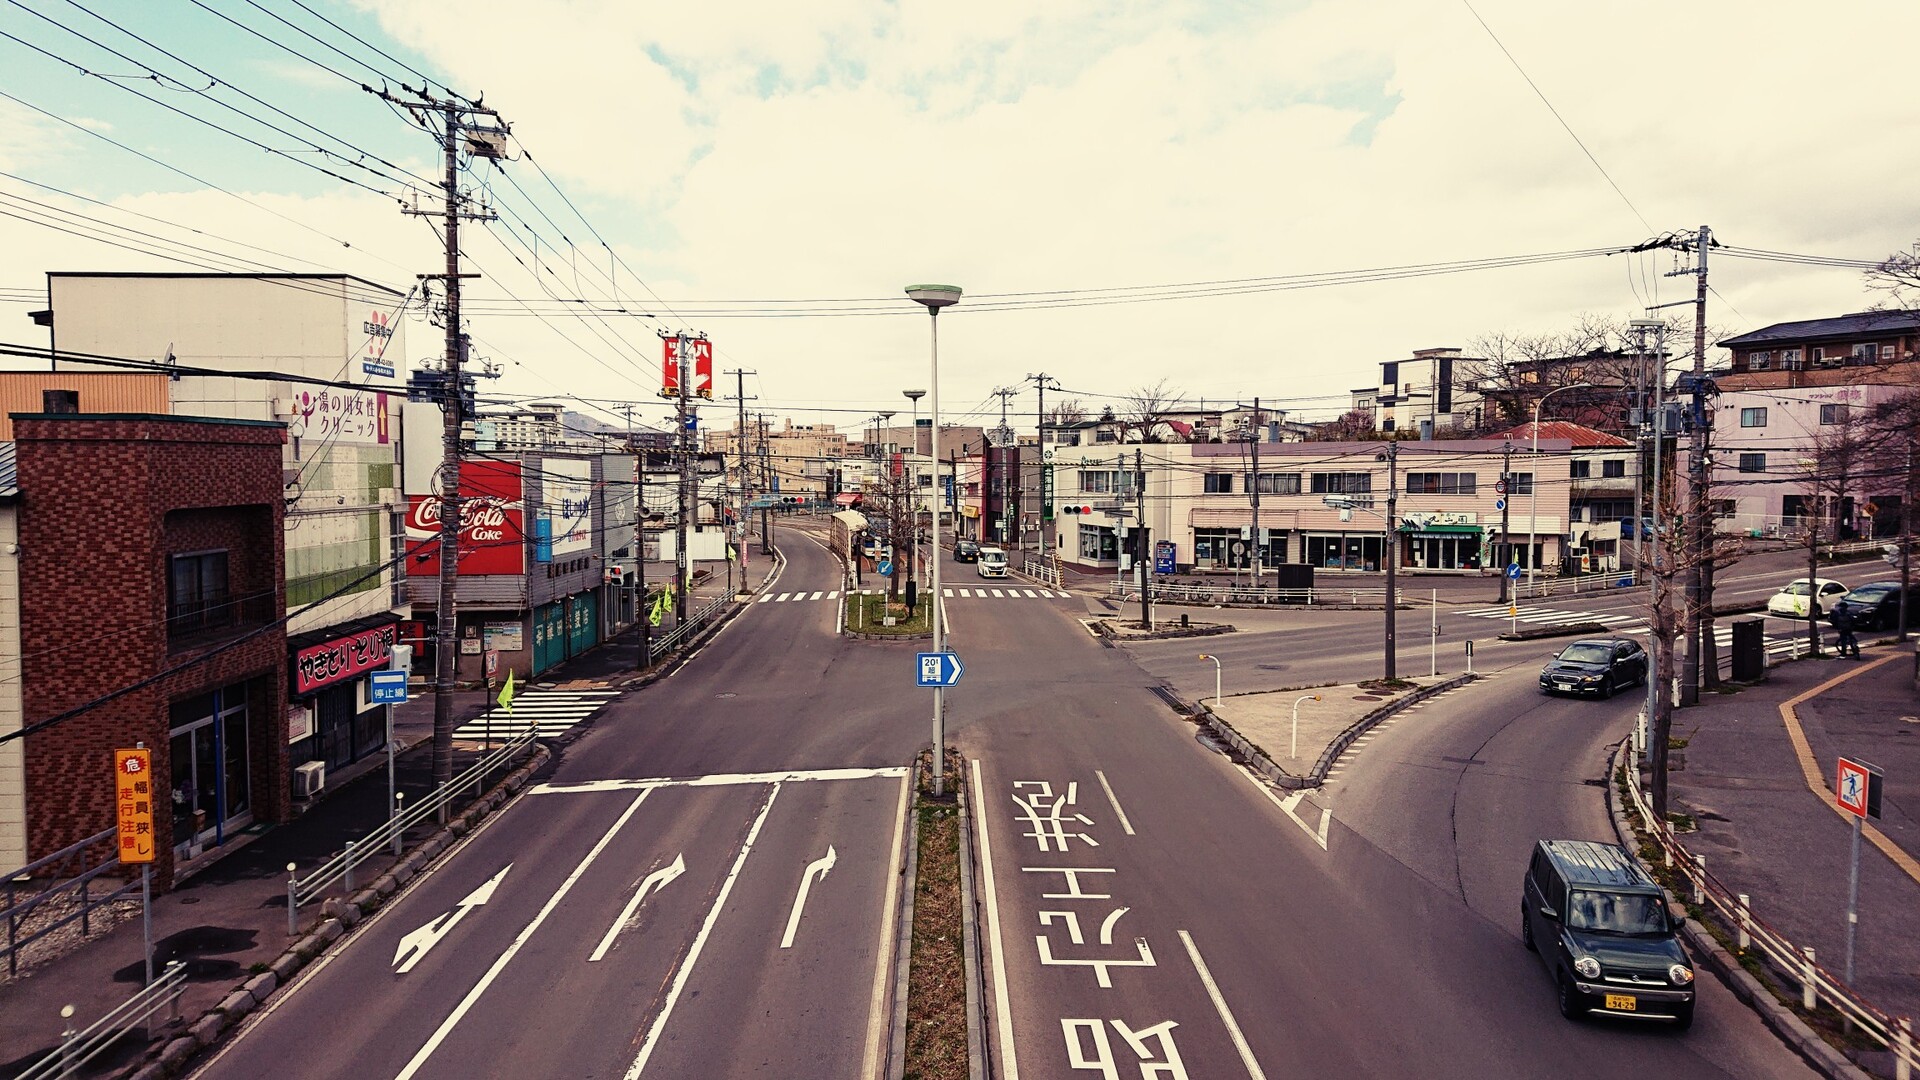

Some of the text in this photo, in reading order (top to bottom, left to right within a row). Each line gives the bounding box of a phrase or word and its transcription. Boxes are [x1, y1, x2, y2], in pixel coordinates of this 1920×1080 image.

[319, 391, 374, 417] 湯の川女性
[320, 416, 374, 437] クリニック
[1044, 468, 1052, 507] 北海道銀行
[471, 527, 503, 540] Coke
[299, 641, 350, 686] やきとり
[374, 688, 405, 699] 停止線
[125, 758, 141, 772] 危
[120, 787, 136, 849] 走行注意
[134, 781, 150, 855] 幅員狭し
